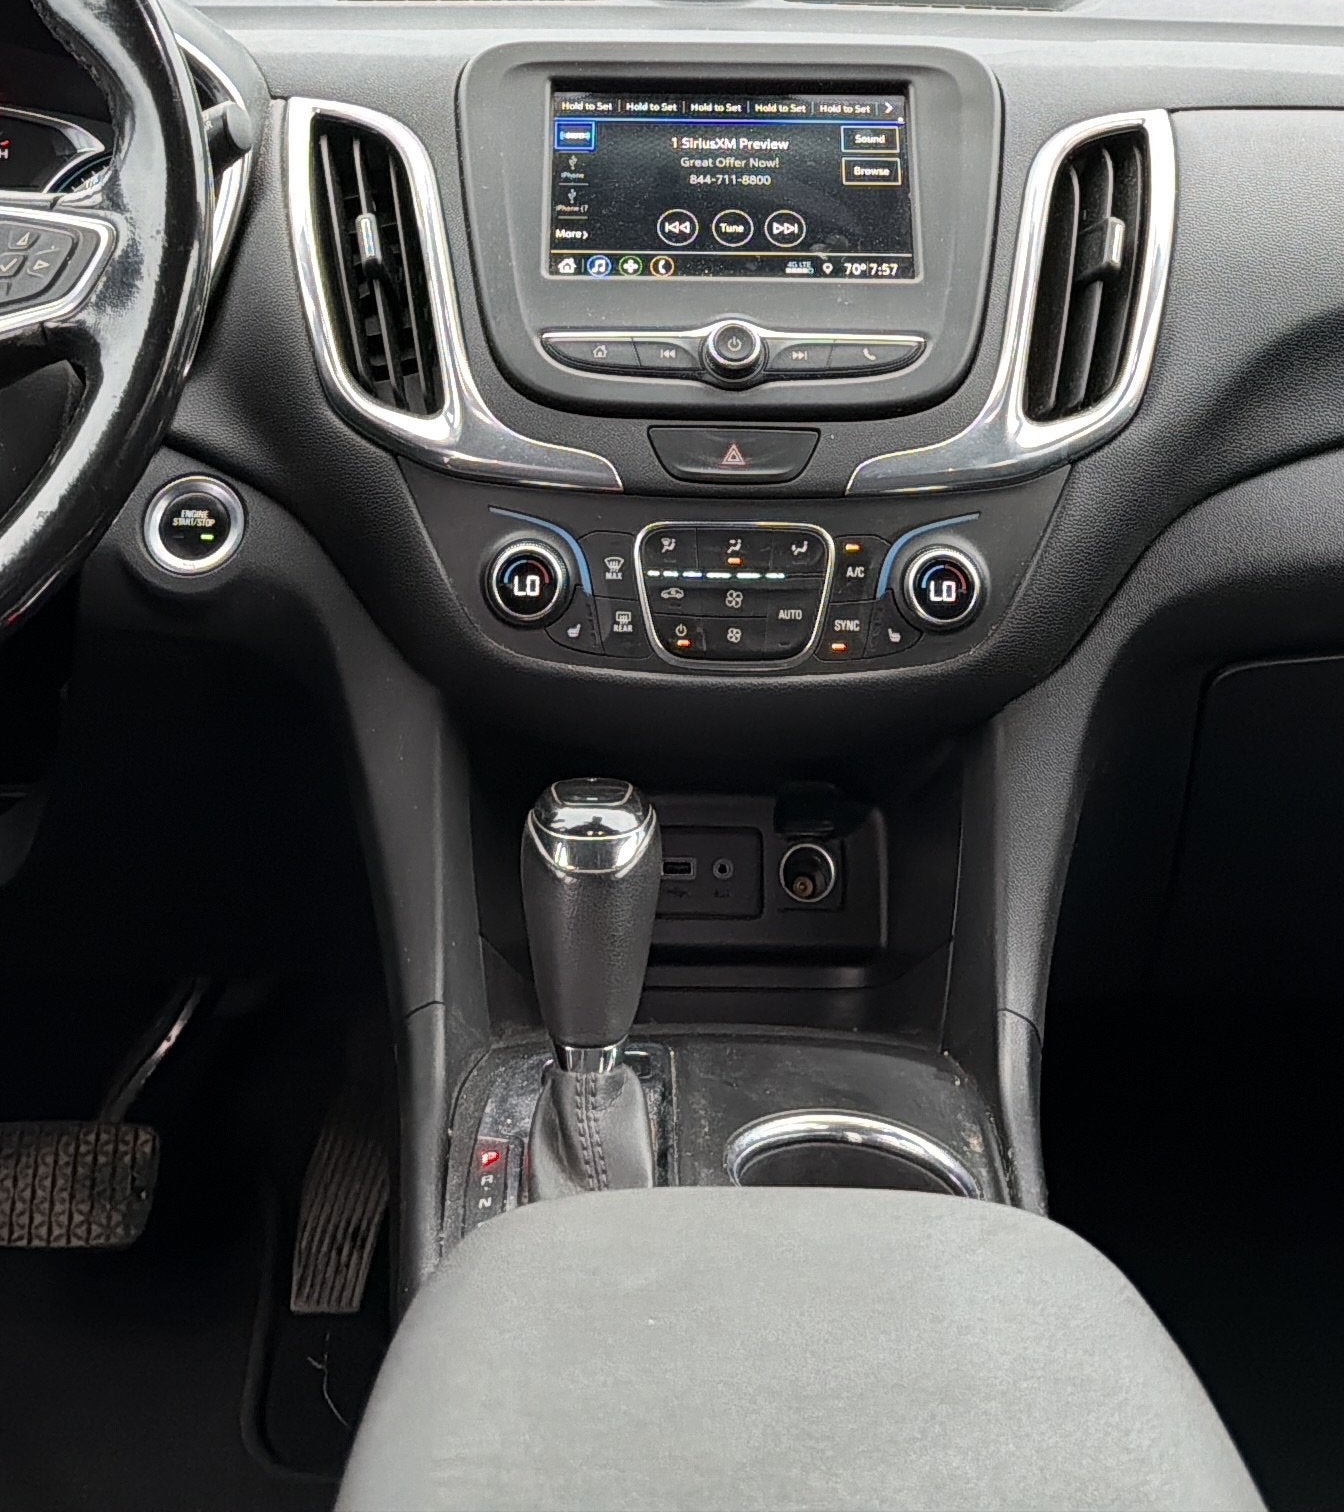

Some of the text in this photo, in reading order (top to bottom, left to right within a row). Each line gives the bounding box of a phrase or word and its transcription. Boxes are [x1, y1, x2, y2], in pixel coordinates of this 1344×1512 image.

[561, 101, 613, 111] Hold to Set
[625, 102, 677, 112] Hold to Set
[690, 103, 742, 112] Hold to Set
[754, 104, 807, 113] Hold to Set
[819, 105, 871, 114] Hold to Set
[671, 137, 789, 151] 1 SiriusXM Preview
[854, 134, 886, 144] Sound
[680, 156, 780, 168] Great Offer Now!
[853, 166, 890, 176] Browse
[689, 174, 772, 186] 844-711-8800
[719, 222, 745, 233] Tune
[556, 228, 582, 239] More
[799, 261, 812, 269] LTE
[843, 263, 867, 276] 70°
[868, 263, 899, 276] 7:57
[180, 509, 210, 519] ENGINE
[172, 517, 216, 528] START/STOP
[605, 572, 623, 580] MAX
[846, 566, 865, 579] A/C
[512, 575, 541, 597] LO
[929, 579, 957, 603] LO
[778, 609, 803, 620] AUTO
[613, 623, 633, 633] REAR
[834, 619, 860, 632] SYNC
[478, 1196, 492, 1210] N
